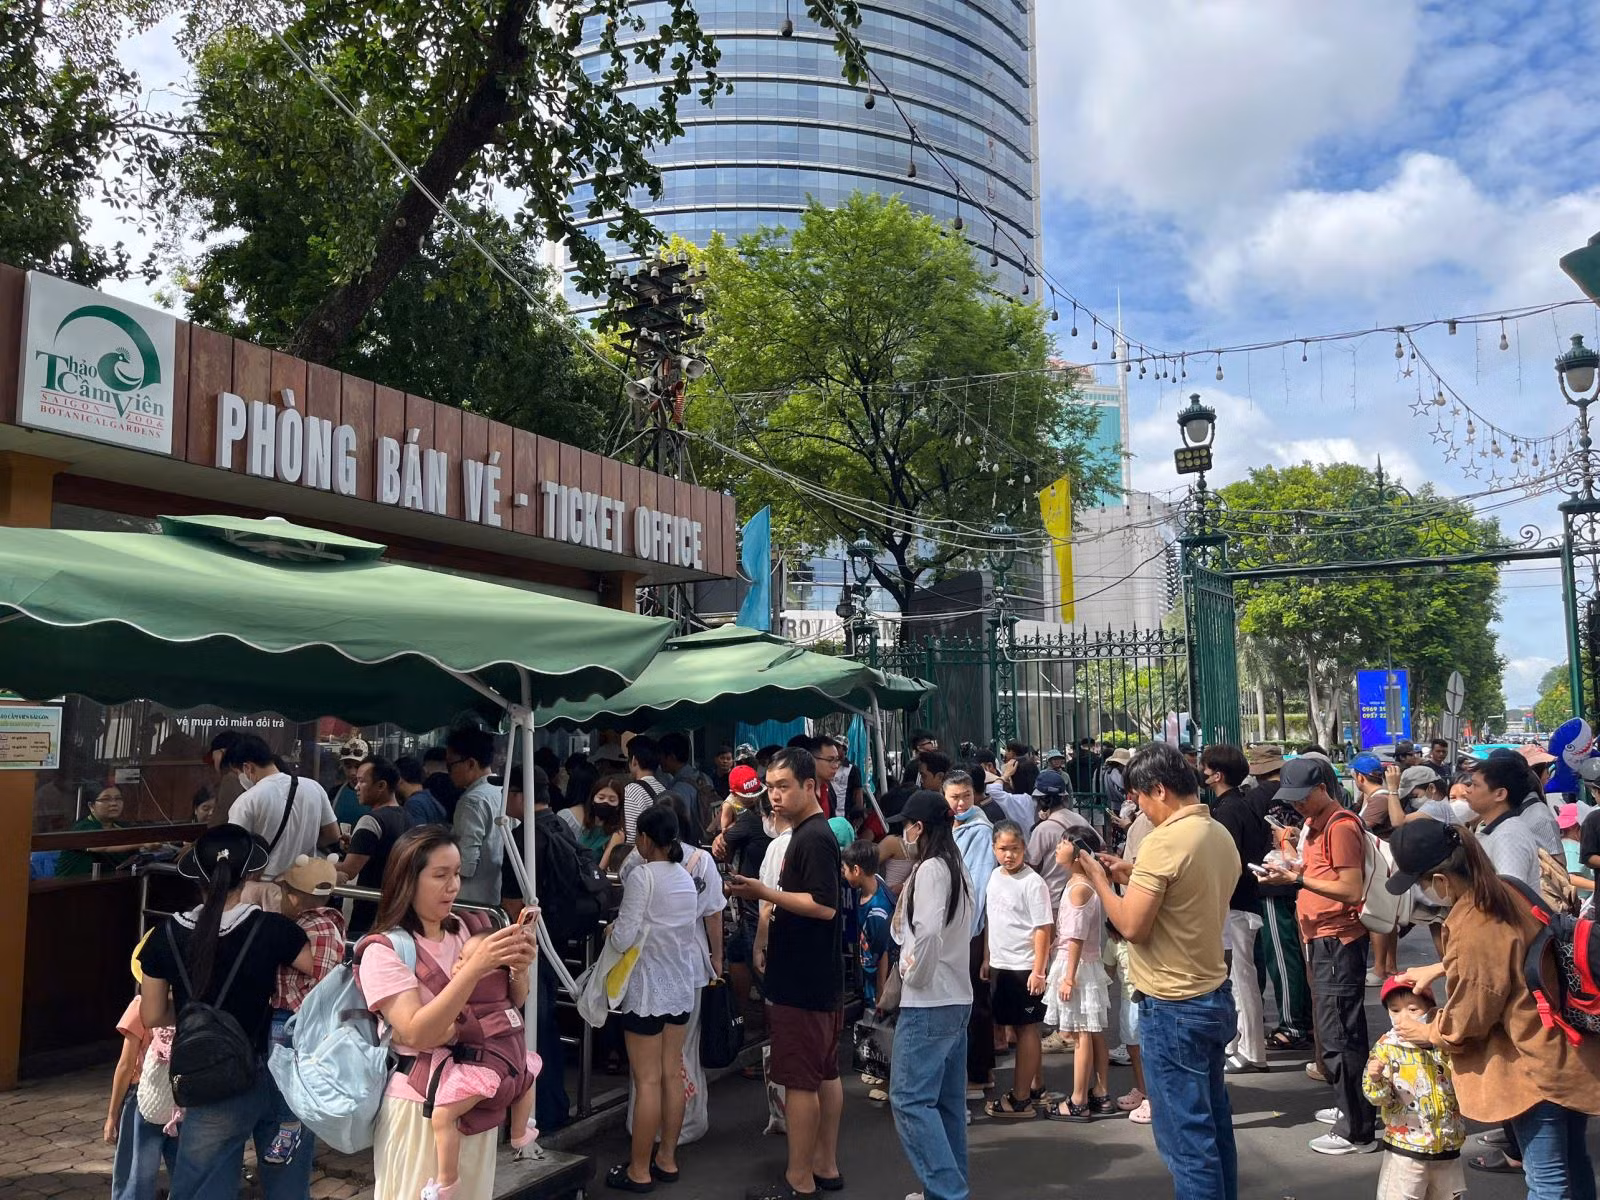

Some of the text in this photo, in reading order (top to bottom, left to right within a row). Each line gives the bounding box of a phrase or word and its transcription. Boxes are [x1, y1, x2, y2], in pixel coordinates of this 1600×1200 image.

[36, 350, 97, 391] Thảo
[58, 371, 111, 403] Cầm
[42, 393, 100, 413] SAIGON
[111, 392, 164, 417] Viên
[215, 388, 357, 496] PHÒNG
[377, 428, 448, 515] BÁN
[463, 450, 502, 527] VÉ
[541, 480, 625, 554] TICKET
[634, 505, 703, 570] OFFICE
[176, 715, 189, 727] vé
[191, 718, 213, 727] mua
